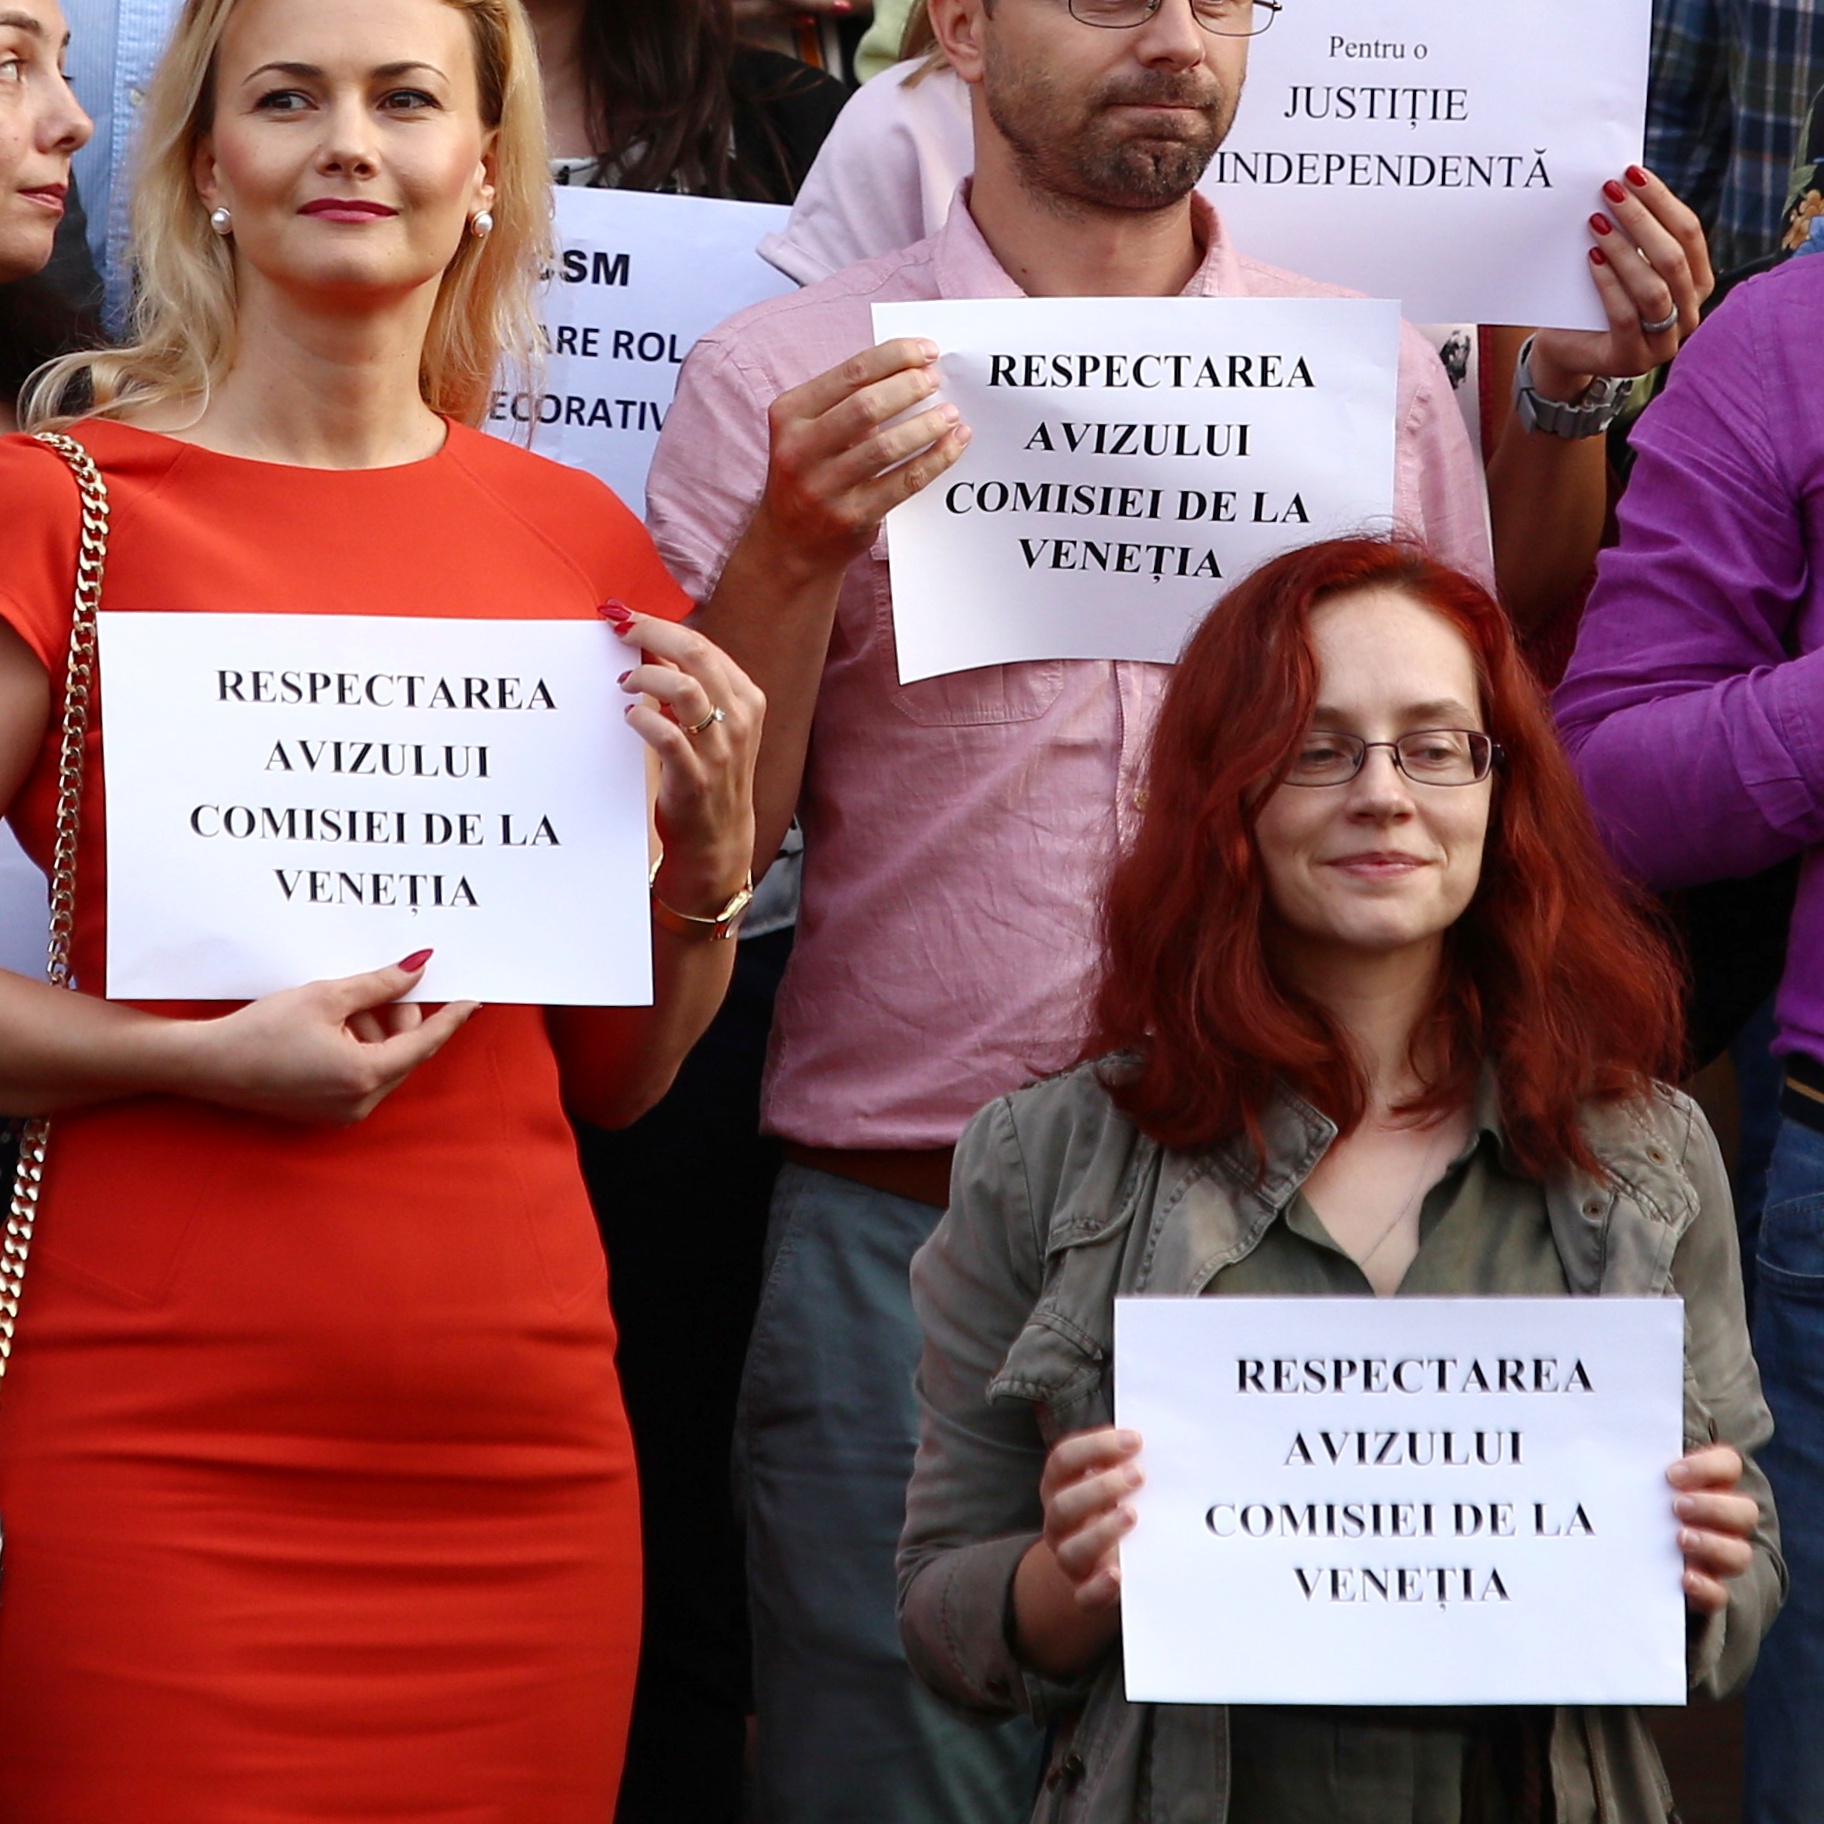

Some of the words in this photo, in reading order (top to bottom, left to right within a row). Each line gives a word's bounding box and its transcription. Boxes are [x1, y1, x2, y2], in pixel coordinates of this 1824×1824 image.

[1328, 35, 1406, 59] Pentru
[1413, 42, 1429, 59] o
[1283, 85, 1469, 129] JUSTIȚIE
[1215, 147, 1553, 189] INDEPENDENTĂ
[612, 331, 684, 364] ROL
[986, 353, 1316, 389] RESPECTAREA
[1023, 421, 1252, 458] AVIZULUI
[944, 480, 1166, 521] COMISIEI
[1174, 490, 1238, 523] DE
[1248, 491, 1311, 524] LA
[1018, 537, 1224, 584] VENEȚIA
[217, 669, 558, 711] RESPECTAREA
[264, 739, 492, 779] AVIZULUI
[189, 804, 409, 845] COMISIEI
[423, 813, 485, 847] DE
[498, 814, 562, 847] LA
[273, 870, 480, 918] VENEȚIA
[1235, 1356, 1595, 1395] RESPECTAREA
[1284, 1431, 1525, 1467] AVIZULUI
[1204, 1503, 1435, 1539] COMISIEI
[1452, 1503, 1515, 1538] DE
[1532, 1503, 1596, 1538] LA
[1294, 1567, 1511, 1611] VENEȚIA
